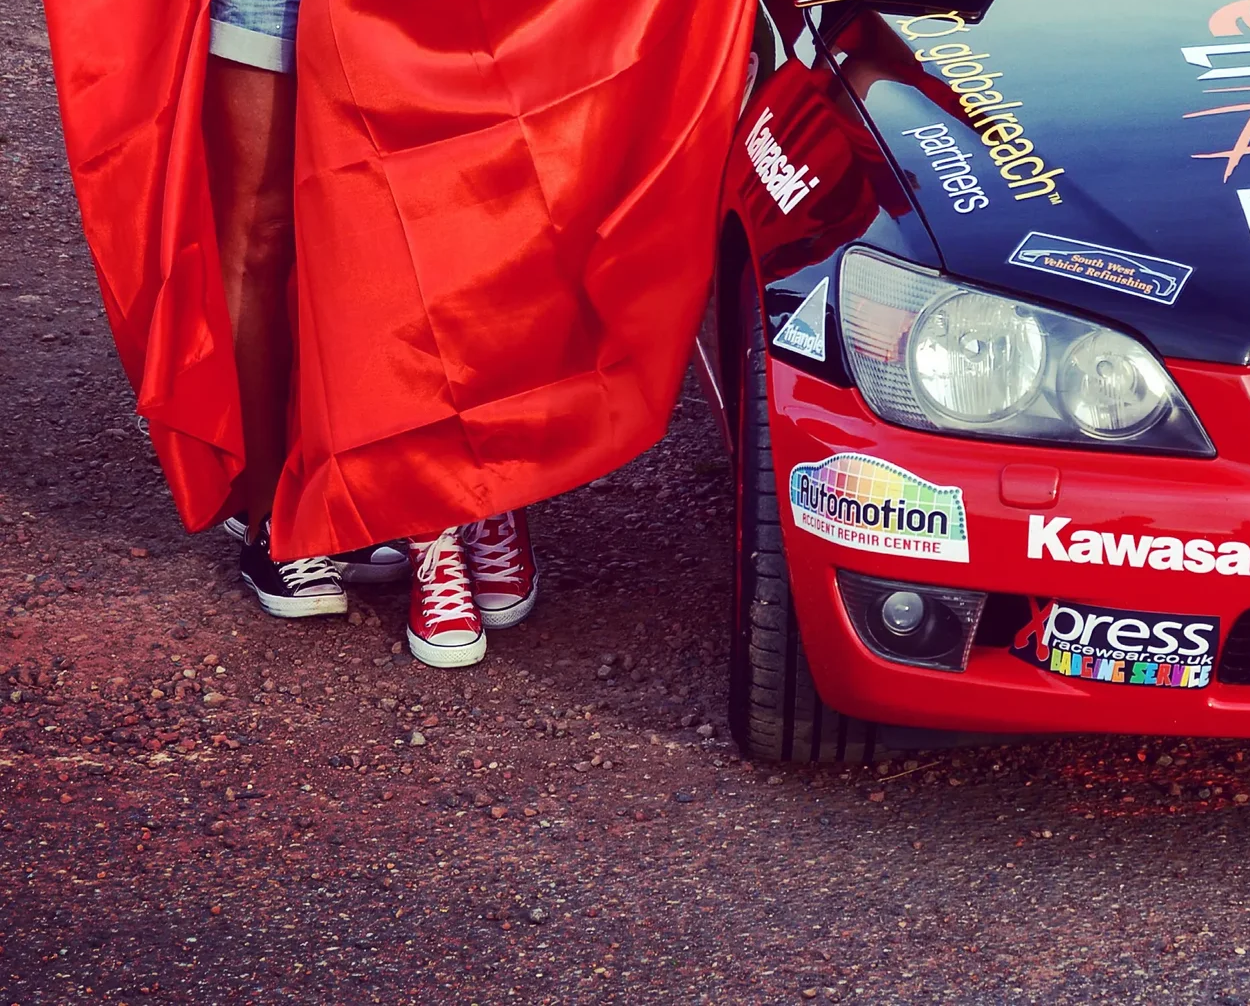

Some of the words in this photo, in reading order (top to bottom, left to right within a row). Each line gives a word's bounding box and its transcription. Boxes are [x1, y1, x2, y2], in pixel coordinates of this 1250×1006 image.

[744, 106, 821, 215] Kawasaki
[901, 122, 990, 214] partners
[1043, 256, 1084, 273] Vehicle
[1085, 267, 1154, 295] Refinishing
[1071, 253, 1105, 269] South
[1107, 261, 1136, 276] West
[783, 323, 824, 352] Triangle
[800, 474, 948, 535] Automotion
[802, 513, 836, 537] ACCIDENT
[837, 527, 880, 547] REPAIR
[884, 536, 942, 554] CENTRE
[1050, 648, 1126, 684] BADGING
[1129, 661, 1213, 690] SERVICE
[1052, 638, 1214, 666] racewear.co.uk
